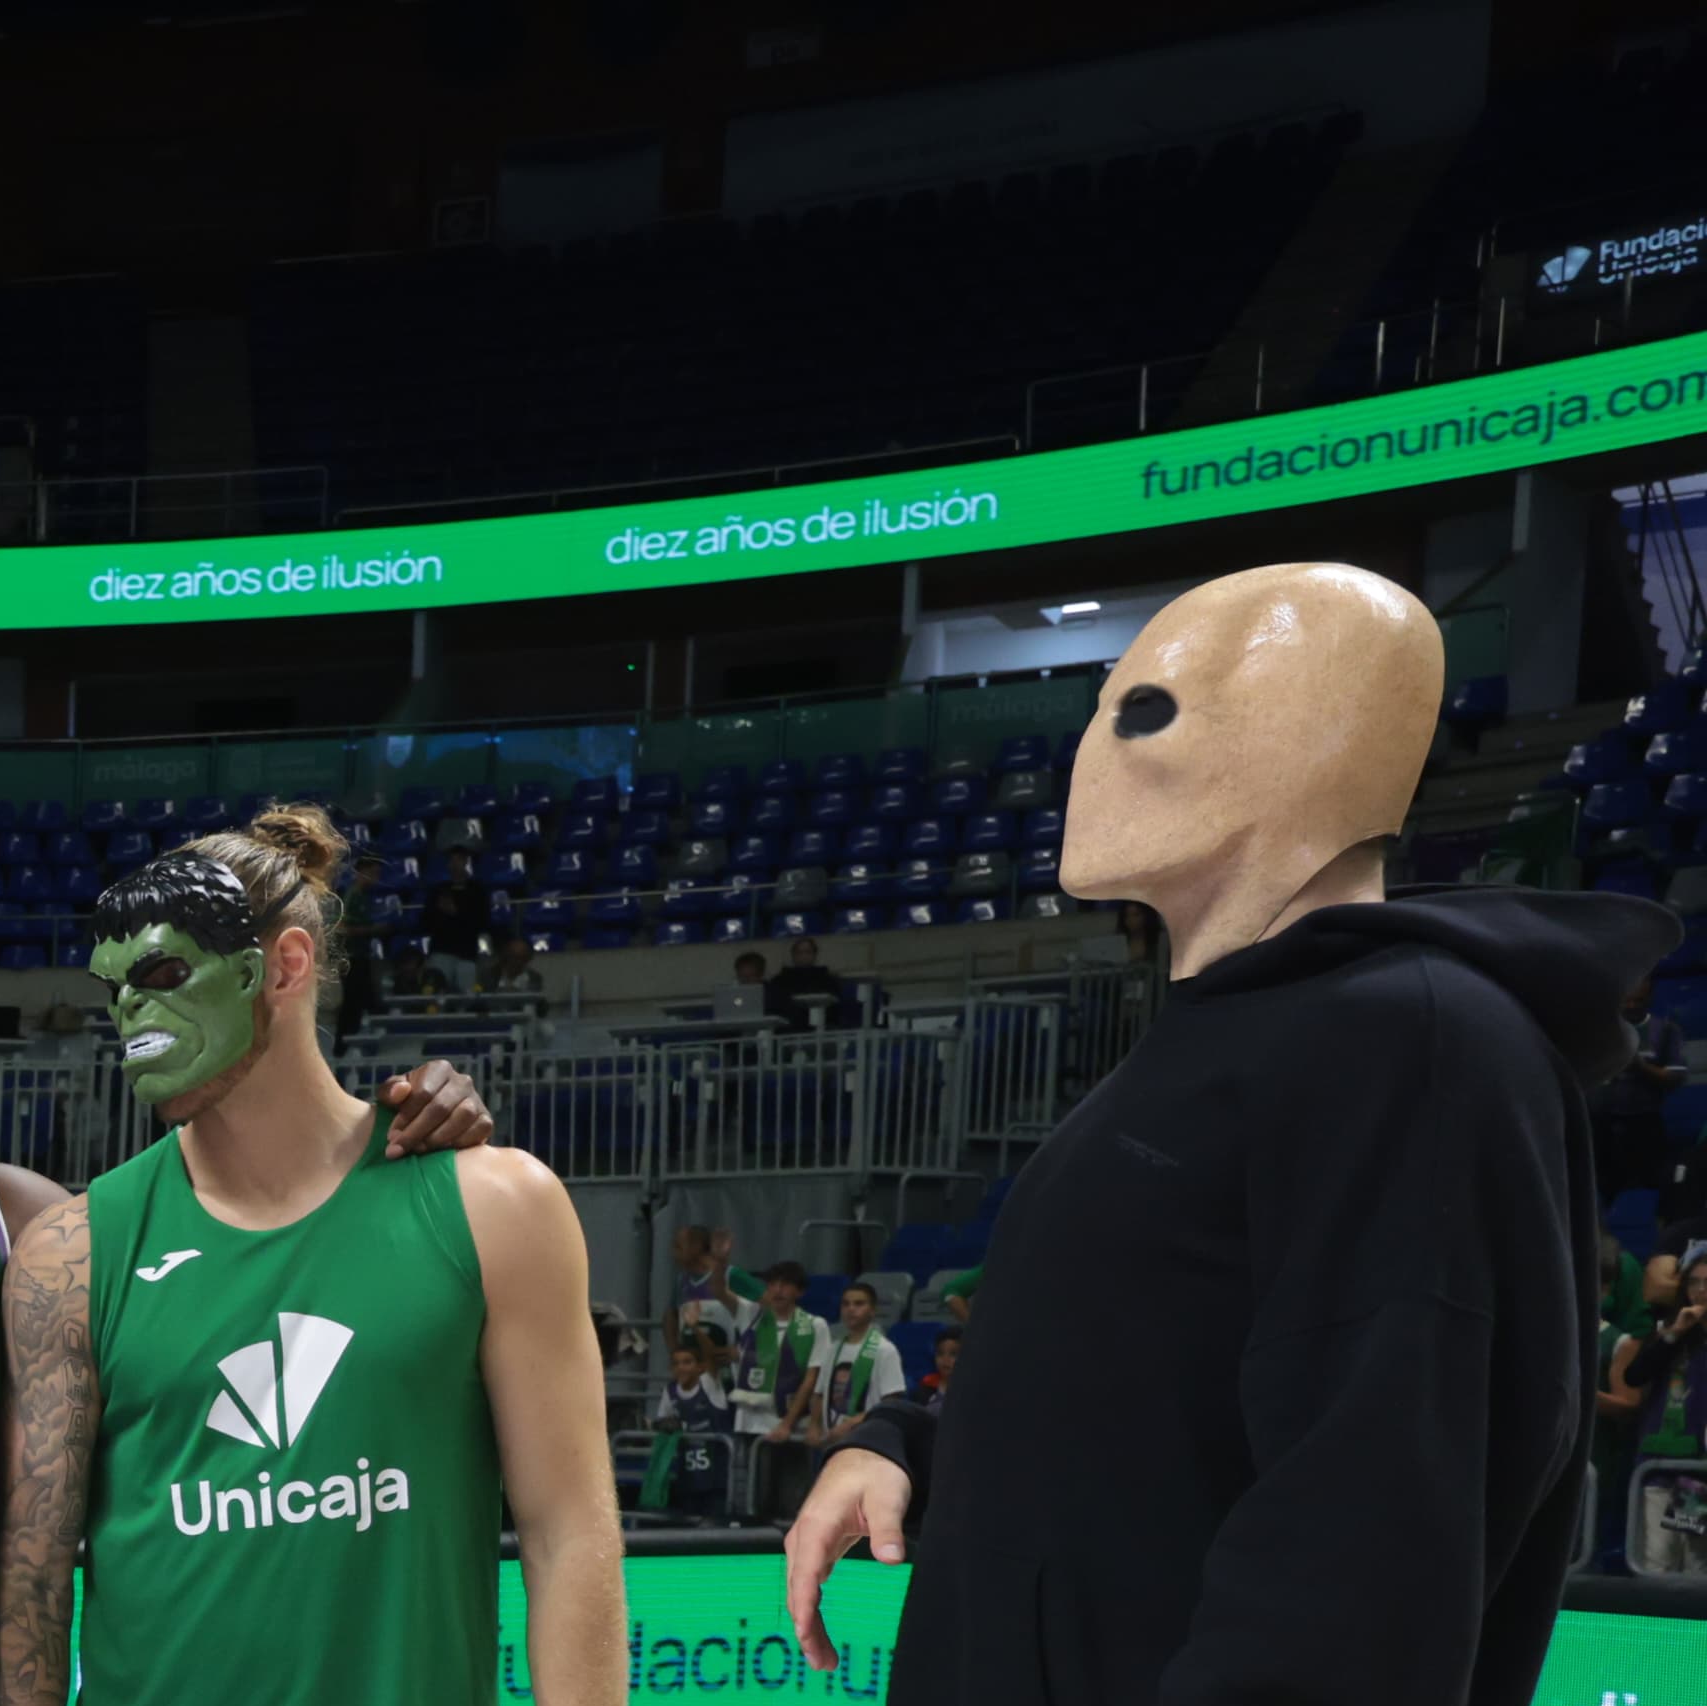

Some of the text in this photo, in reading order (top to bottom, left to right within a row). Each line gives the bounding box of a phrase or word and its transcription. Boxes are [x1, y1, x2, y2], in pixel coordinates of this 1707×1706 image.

[1598, 217, 1707, 263] Fundaci
[605, 487, 999, 565] diez años de ilusión
[89, 549, 443, 603] diez años de ilusión
[172, 1456, 410, 1537] Unicaja
